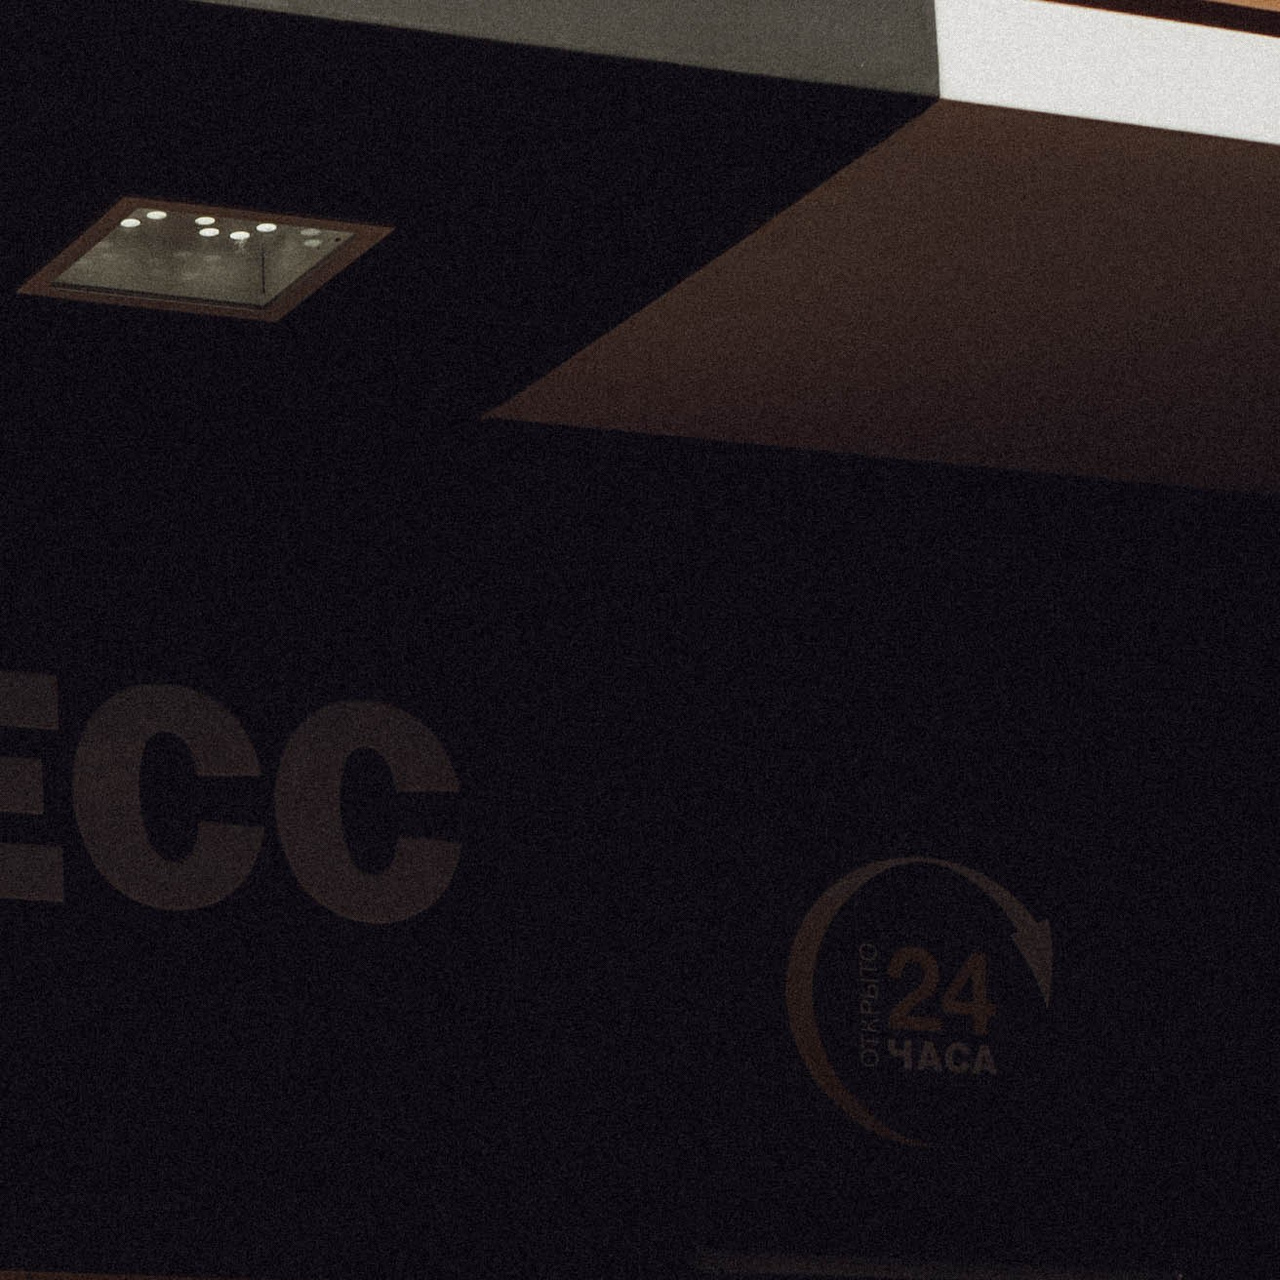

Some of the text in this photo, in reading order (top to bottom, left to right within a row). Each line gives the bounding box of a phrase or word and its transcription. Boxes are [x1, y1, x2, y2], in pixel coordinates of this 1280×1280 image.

[859, 942, 878, 1068] ОТКРЫТО
[887, 947, 996, 1035] 24
[887, 1038, 997, 1075] ЧАСА
